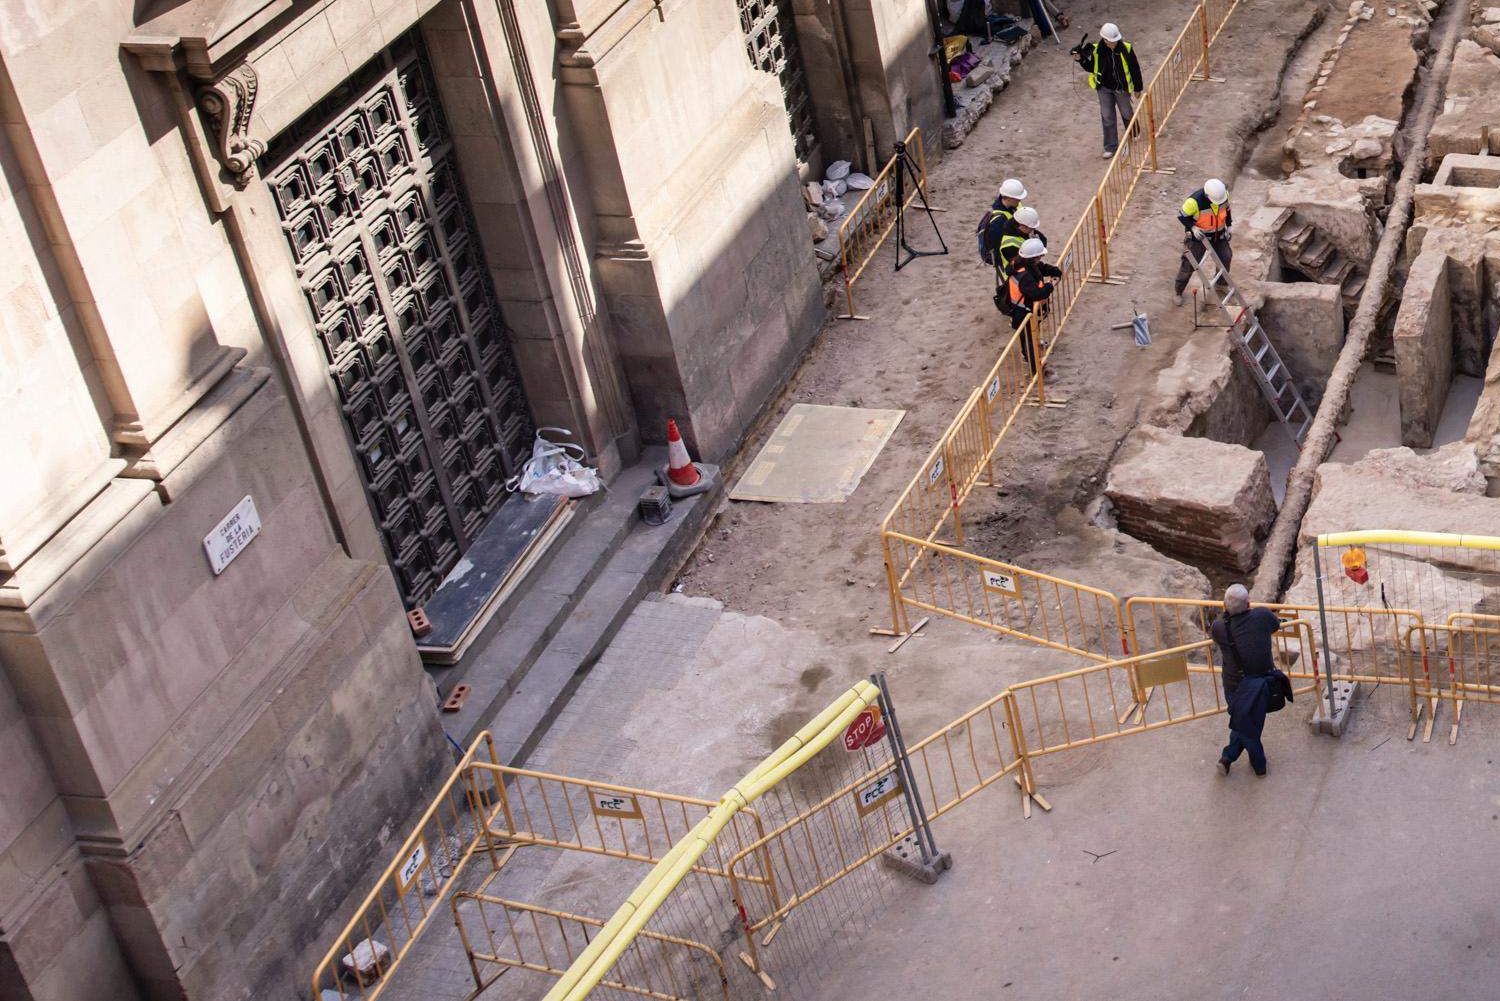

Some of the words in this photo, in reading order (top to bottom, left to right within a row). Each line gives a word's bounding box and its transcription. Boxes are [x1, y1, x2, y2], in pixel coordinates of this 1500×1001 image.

[219, 513, 241, 536] CARRER
[225, 531, 234, 544] DE
[234, 525, 242, 535] LA
[219, 525, 255, 564] FUSTERIA
[990, 575, 1006, 588] FCC
[846, 716, 872, 747] STOP
[865, 785, 885, 803] FCC
[600, 799, 621, 810] FCC
